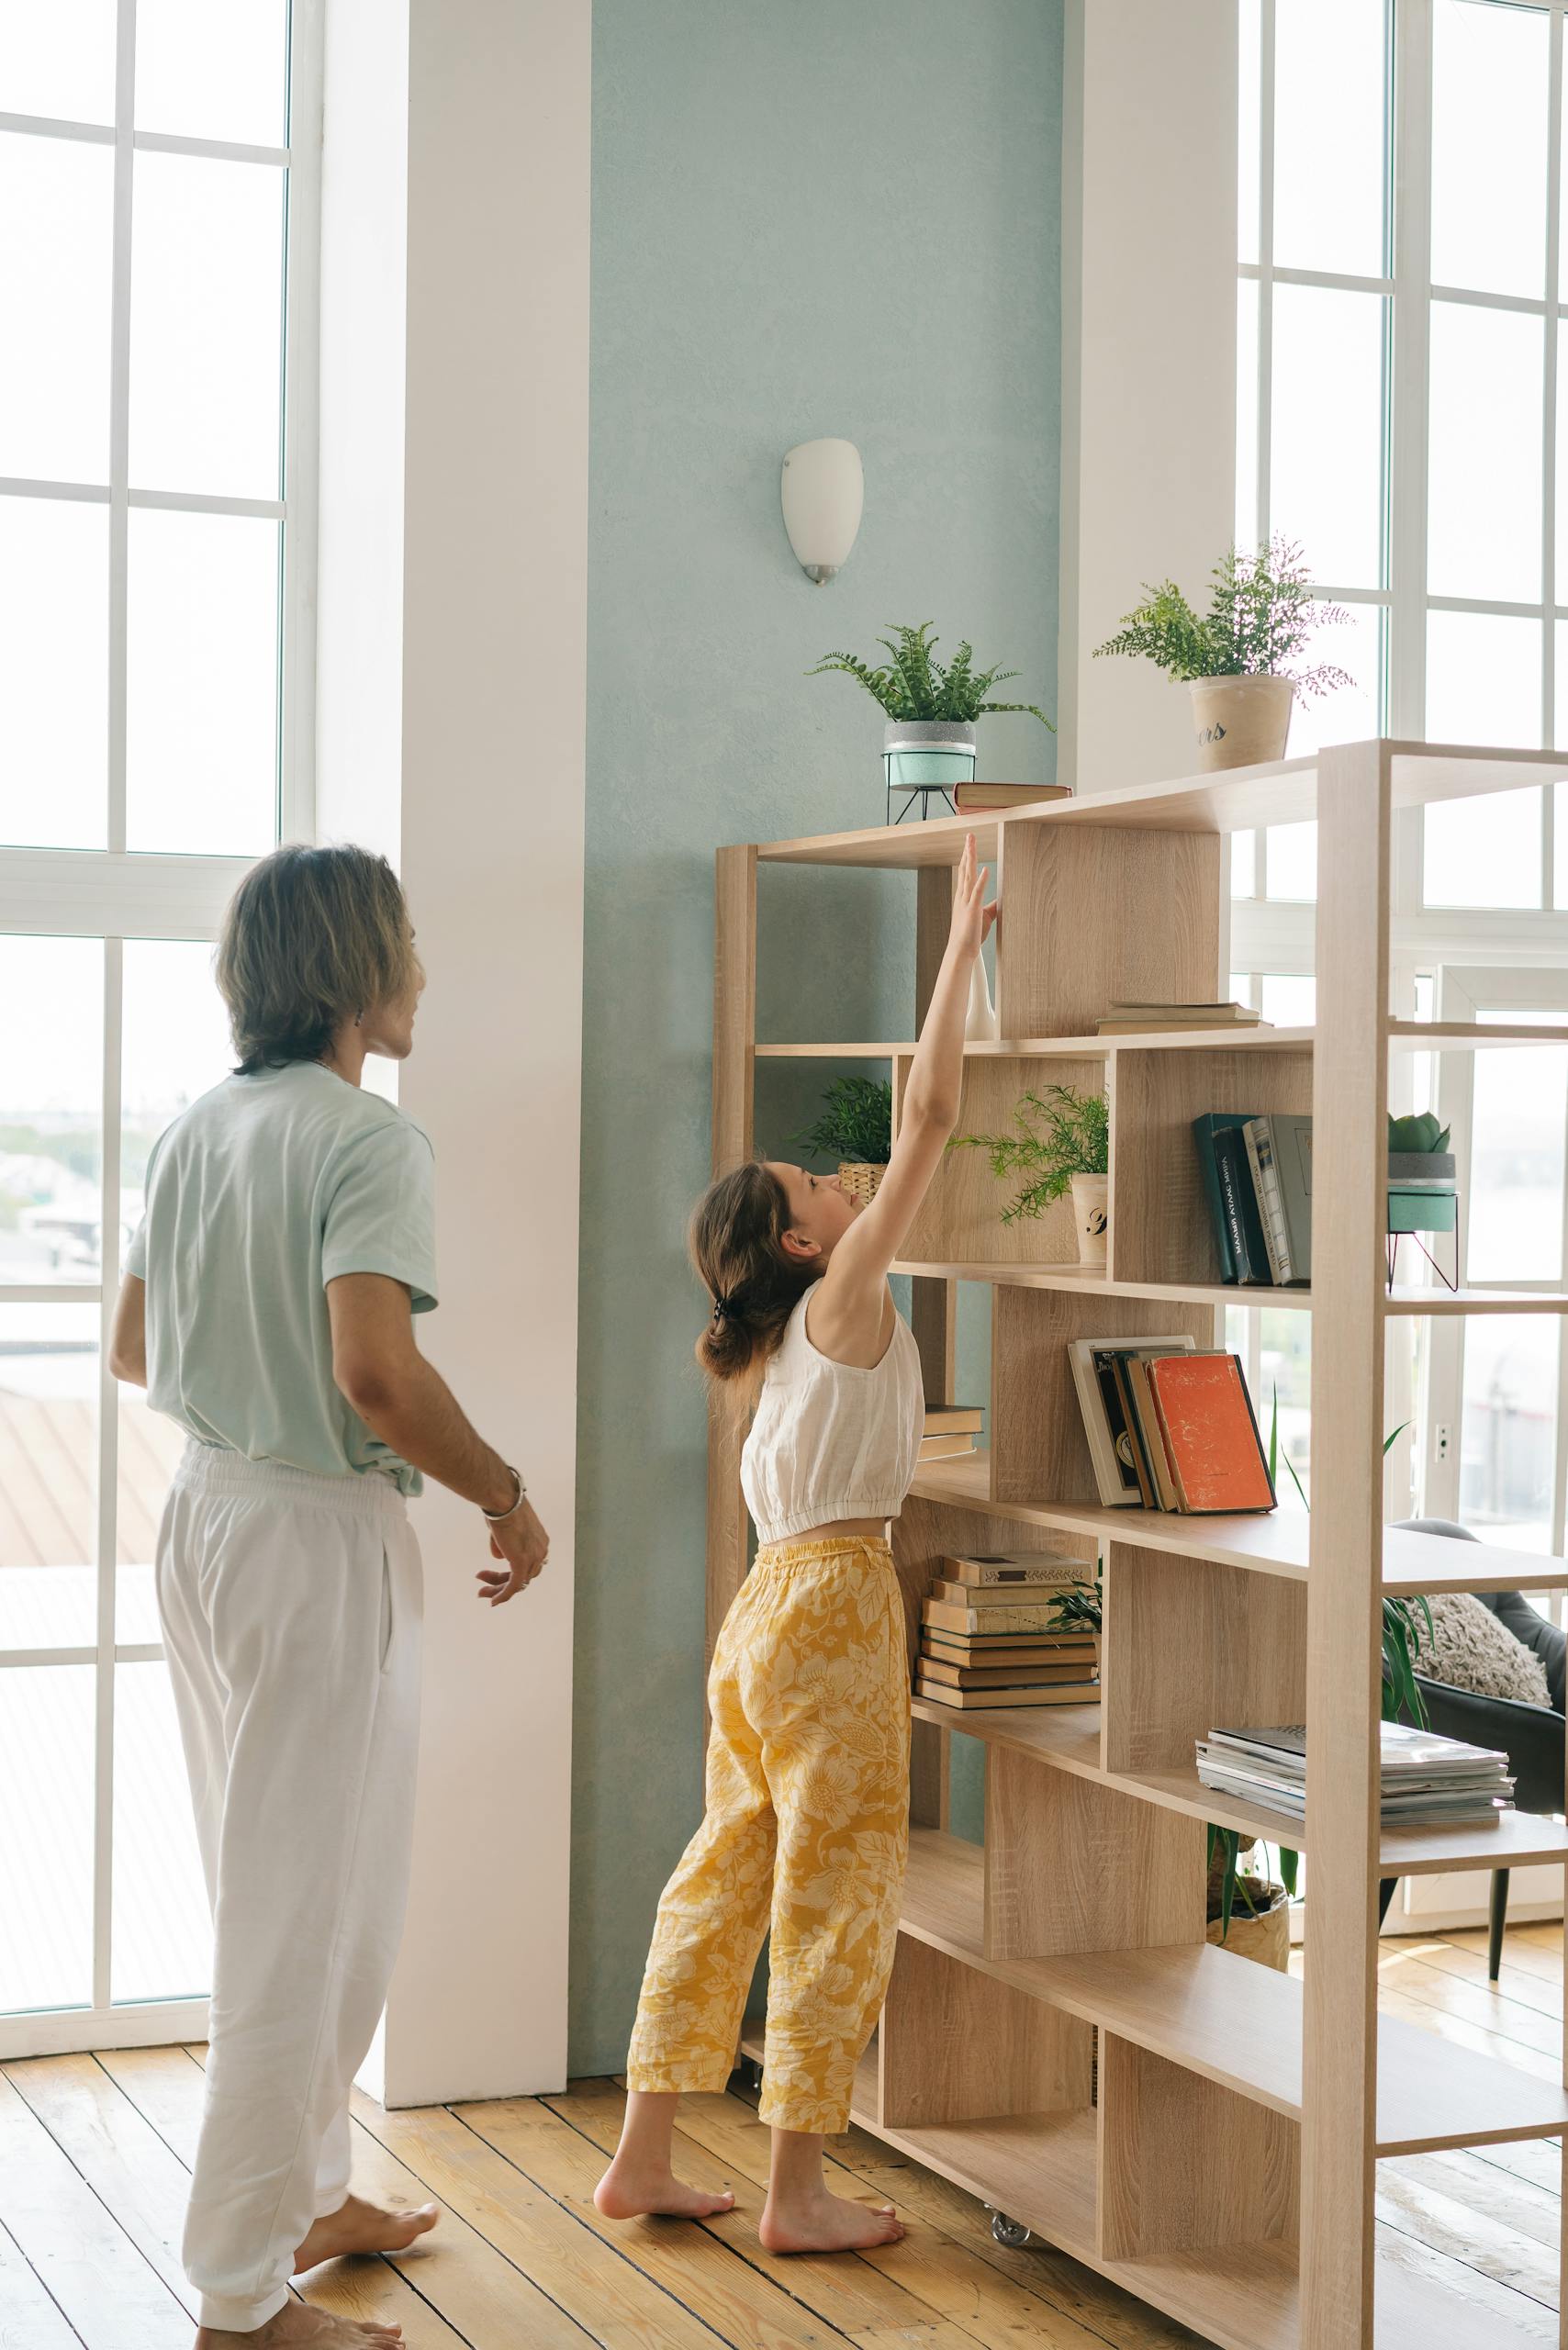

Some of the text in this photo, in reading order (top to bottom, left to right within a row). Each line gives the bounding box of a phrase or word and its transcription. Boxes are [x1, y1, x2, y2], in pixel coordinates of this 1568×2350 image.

[1222, 1156, 1241, 1255] МАЛЫЙ АТЛАС МИРА
